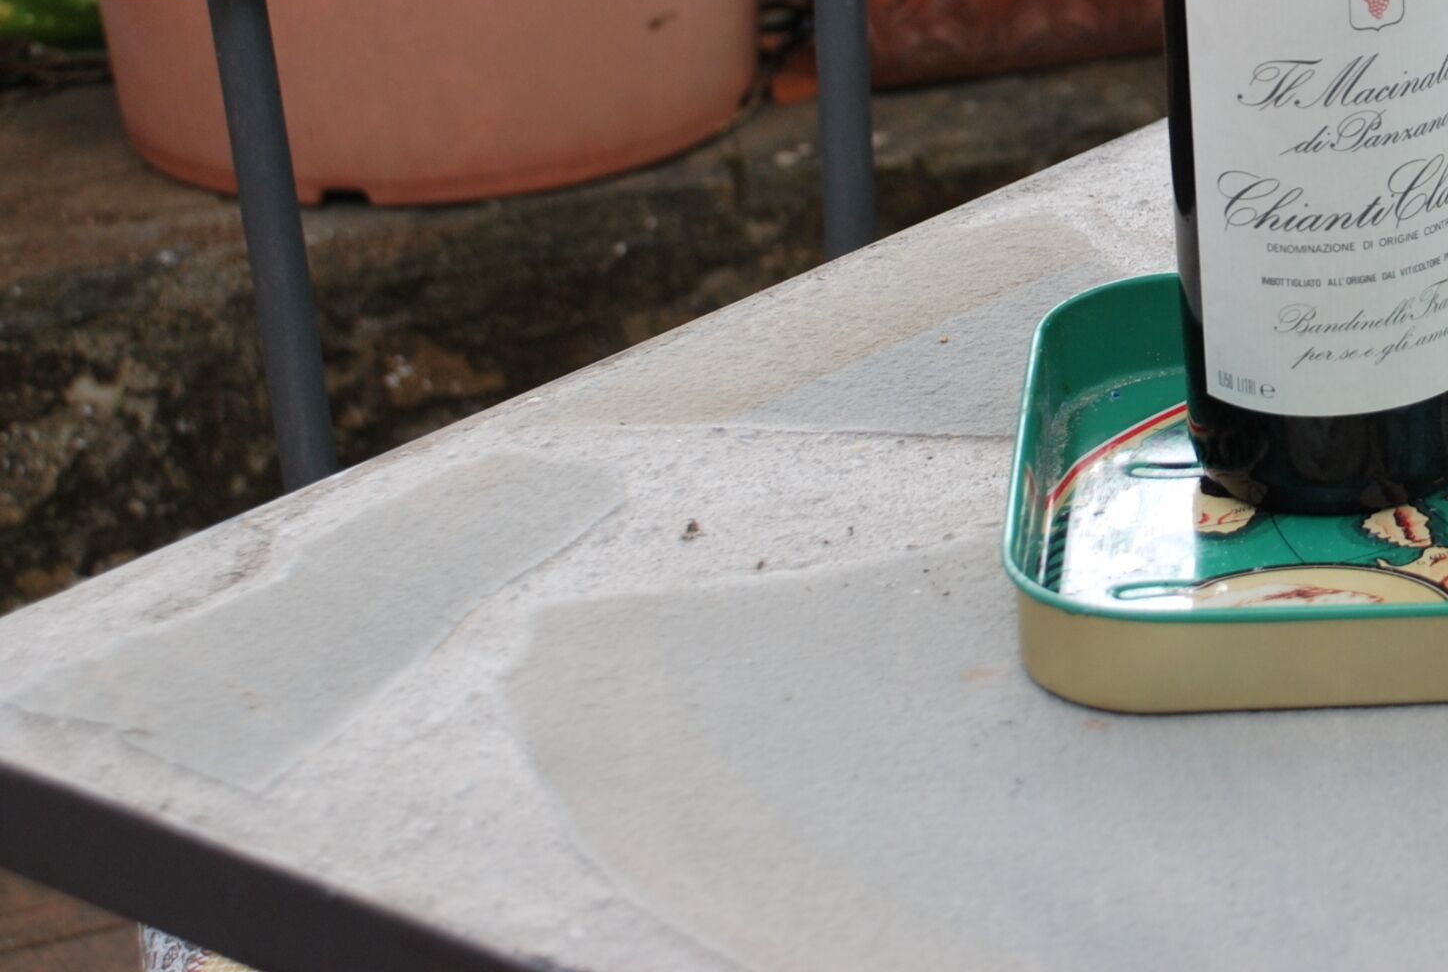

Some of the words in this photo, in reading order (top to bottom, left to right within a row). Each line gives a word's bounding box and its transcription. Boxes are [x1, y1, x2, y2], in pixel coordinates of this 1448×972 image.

[1280, 124, 1332, 156] di
[1217, 170, 1396, 232] Chianti
[1266, 241, 1356, 254] DENOMINAZIONE
[1362, 240, 1374, 251] DI
[1378, 231, 1419, 247] ORIGINE
[1261, 276, 1322, 288] IMBOTTIGLIATO
[1381, 270, 1397, 281] DAL
[1400, 256, 1441, 277] VITICOLTORE
[1273, 295, 1413, 336] Bandinelli
[1290, 345, 1333, 370] per
[1374, 325, 1413, 365] gli
